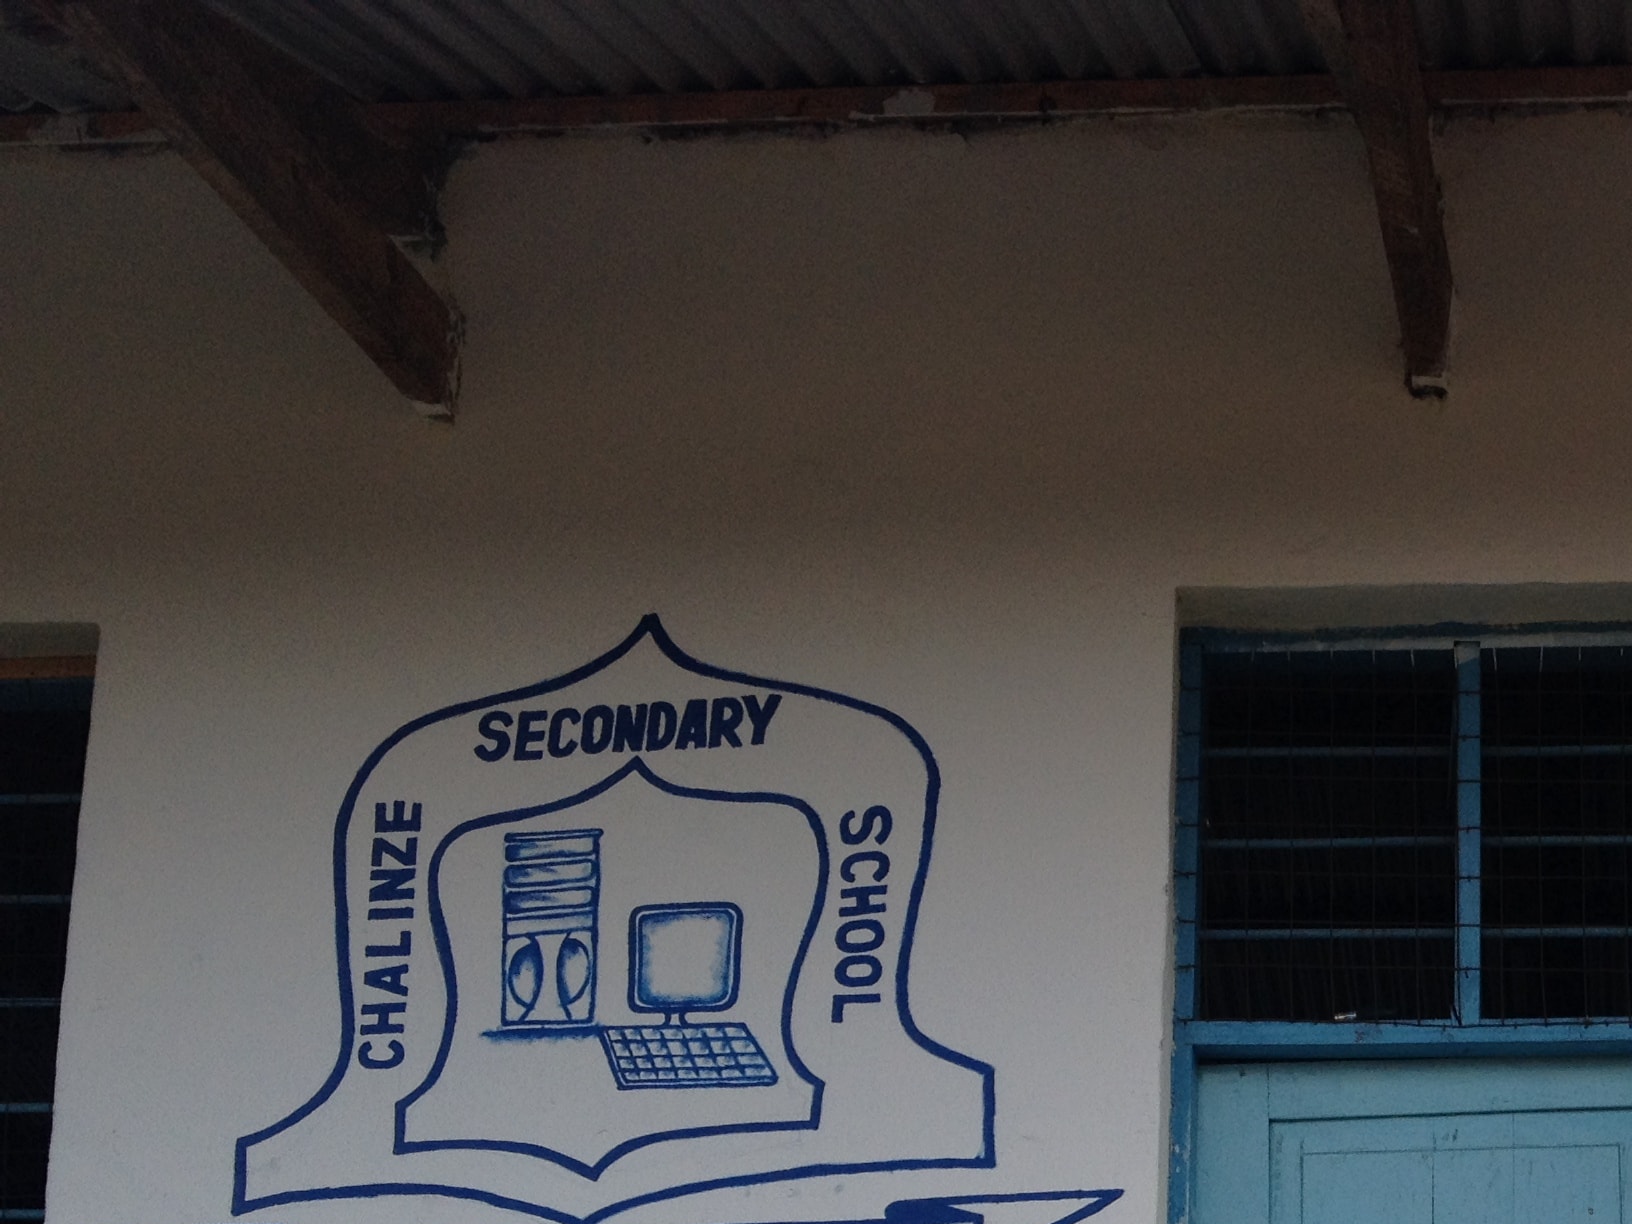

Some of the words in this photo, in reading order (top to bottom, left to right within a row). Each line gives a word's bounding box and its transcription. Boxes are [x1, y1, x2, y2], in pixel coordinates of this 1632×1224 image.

[356, 800, 422, 1070] CHALINZE
[473, 693, 783, 763] SECONDARY
[830, 804, 892, 1023] SCHOOL
